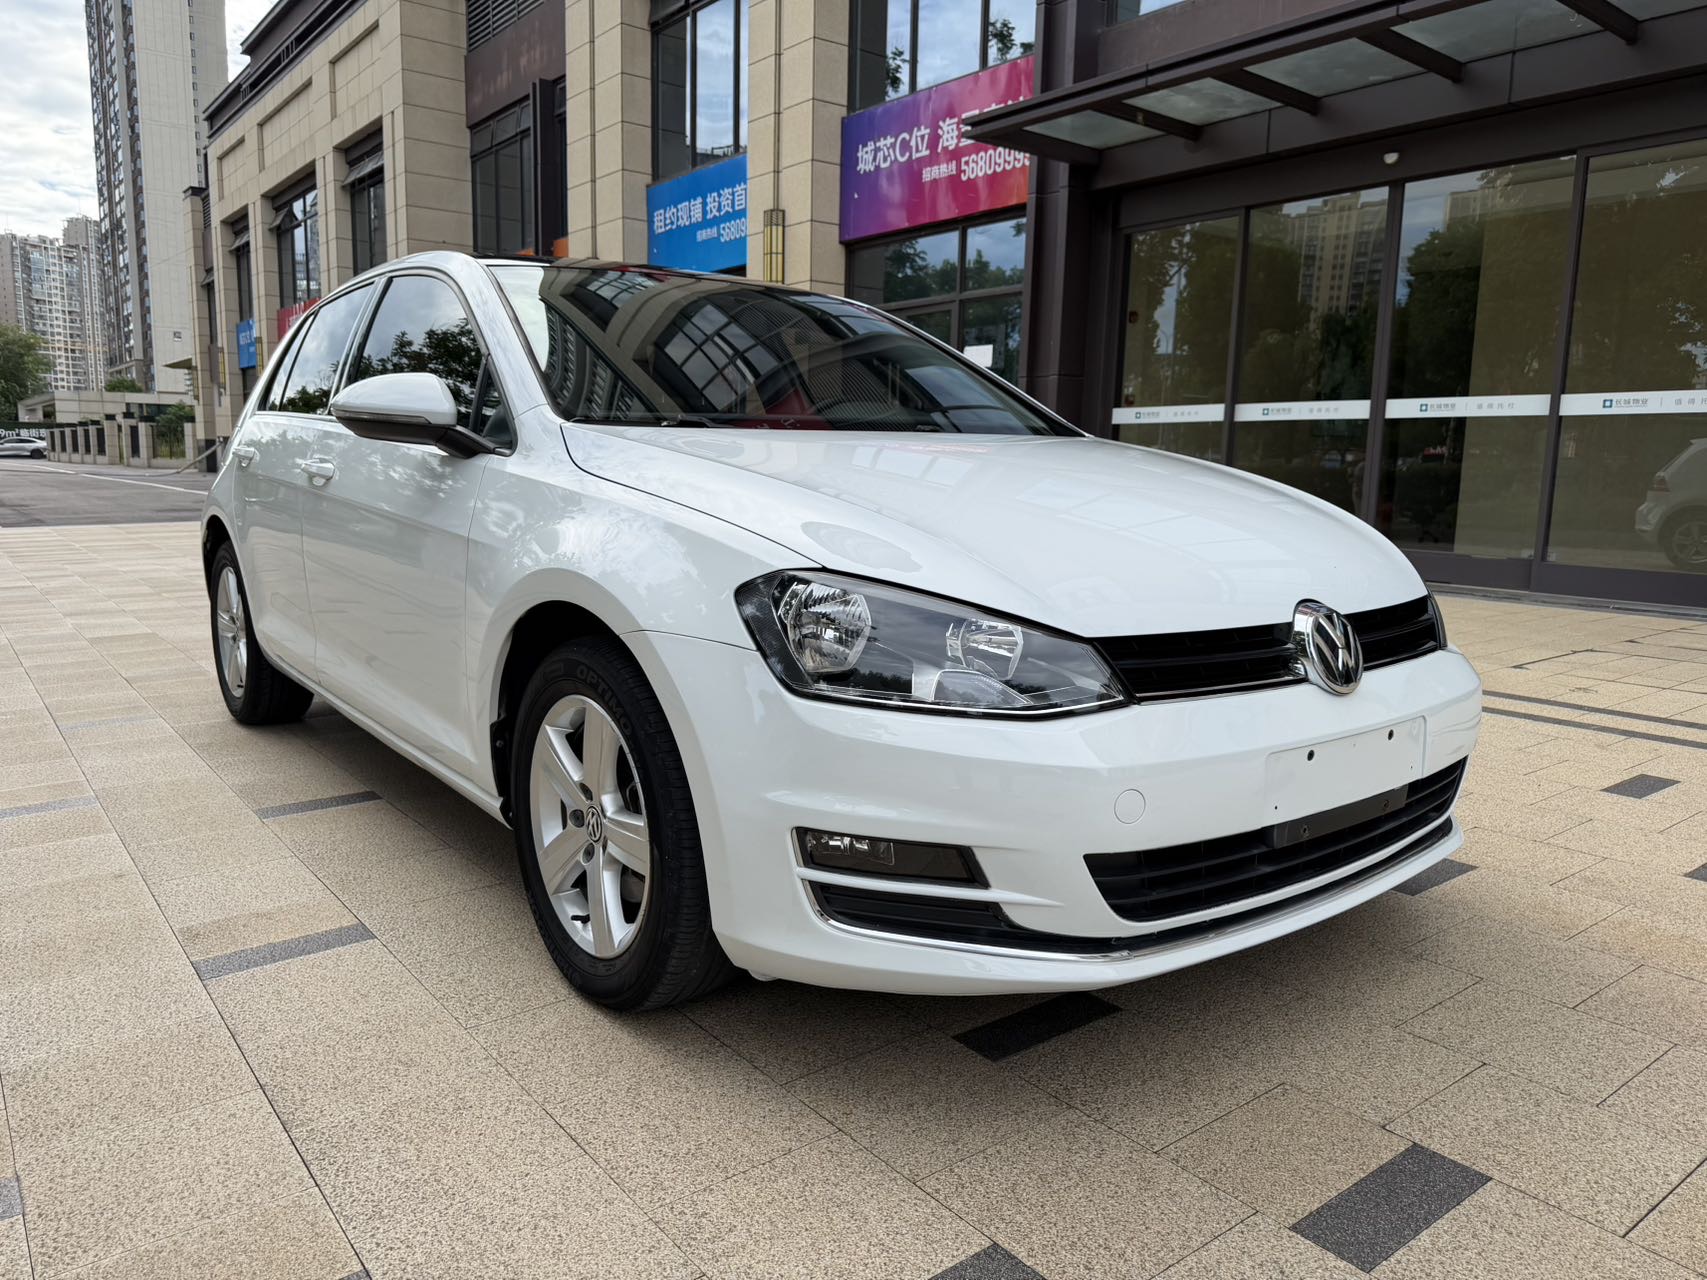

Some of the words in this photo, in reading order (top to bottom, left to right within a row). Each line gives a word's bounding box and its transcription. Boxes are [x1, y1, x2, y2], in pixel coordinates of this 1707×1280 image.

[857, 126, 930, 175] 城芯C位
[922, 160, 957, 182] 招商热线
[653, 196, 703, 235] 租约现铺
[706, 182, 747, 219] 投资首
[576, 664, 633, 736] OPTIMO
